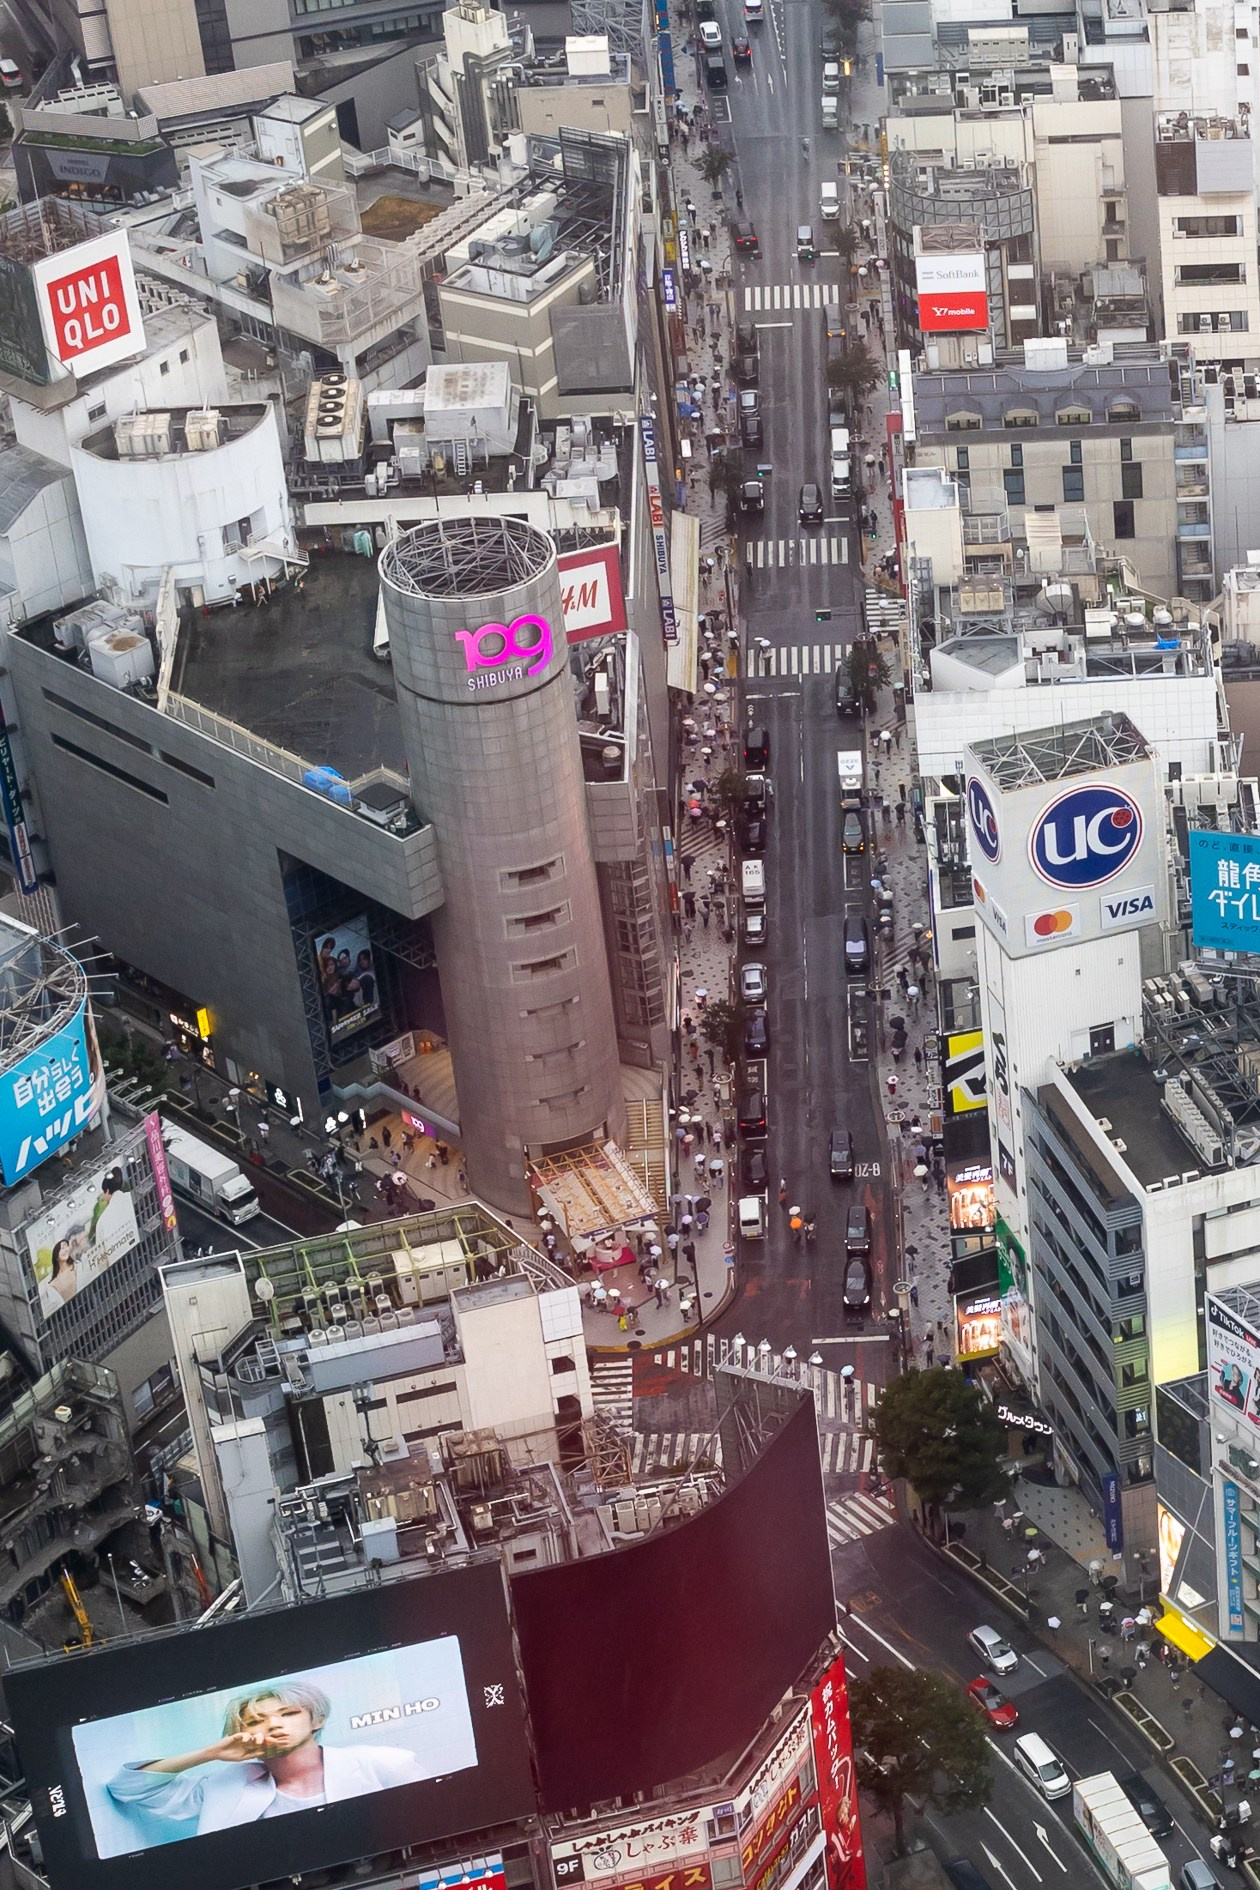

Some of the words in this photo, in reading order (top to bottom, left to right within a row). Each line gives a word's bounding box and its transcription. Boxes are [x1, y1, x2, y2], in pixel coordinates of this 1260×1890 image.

[59, 165, 100, 178] INDIGO
[936, 268, 980, 281] SoftBank
[57, 270, 112, 315] UNI
[63, 303, 121, 350] QLO
[949, 308, 976, 317] mobile
[642, 427, 656, 462] LABI
[649, 495, 663, 528] LABI
[655, 534, 667, 575] SHIBUYA
[662, 608, 676, 639] LABI
[455, 614, 553, 677] 109
[468, 667, 522, 692] SHIBUYA
[1043, 806, 1132, 866] UC
[1104, 895, 1154, 919] VISA
[38, 1065, 84, 1117] 出会う
[1218, 1311, 1246, 1340] TikTok
[997, 1405, 1055, 1435] グルメタウン
[350, 1705, 399, 1730] MIN
[404, 1696, 441, 1719] HO
[625, 1826, 699, 1859] しゃぶ葉
[556, 1859, 579, 1876] 9F
